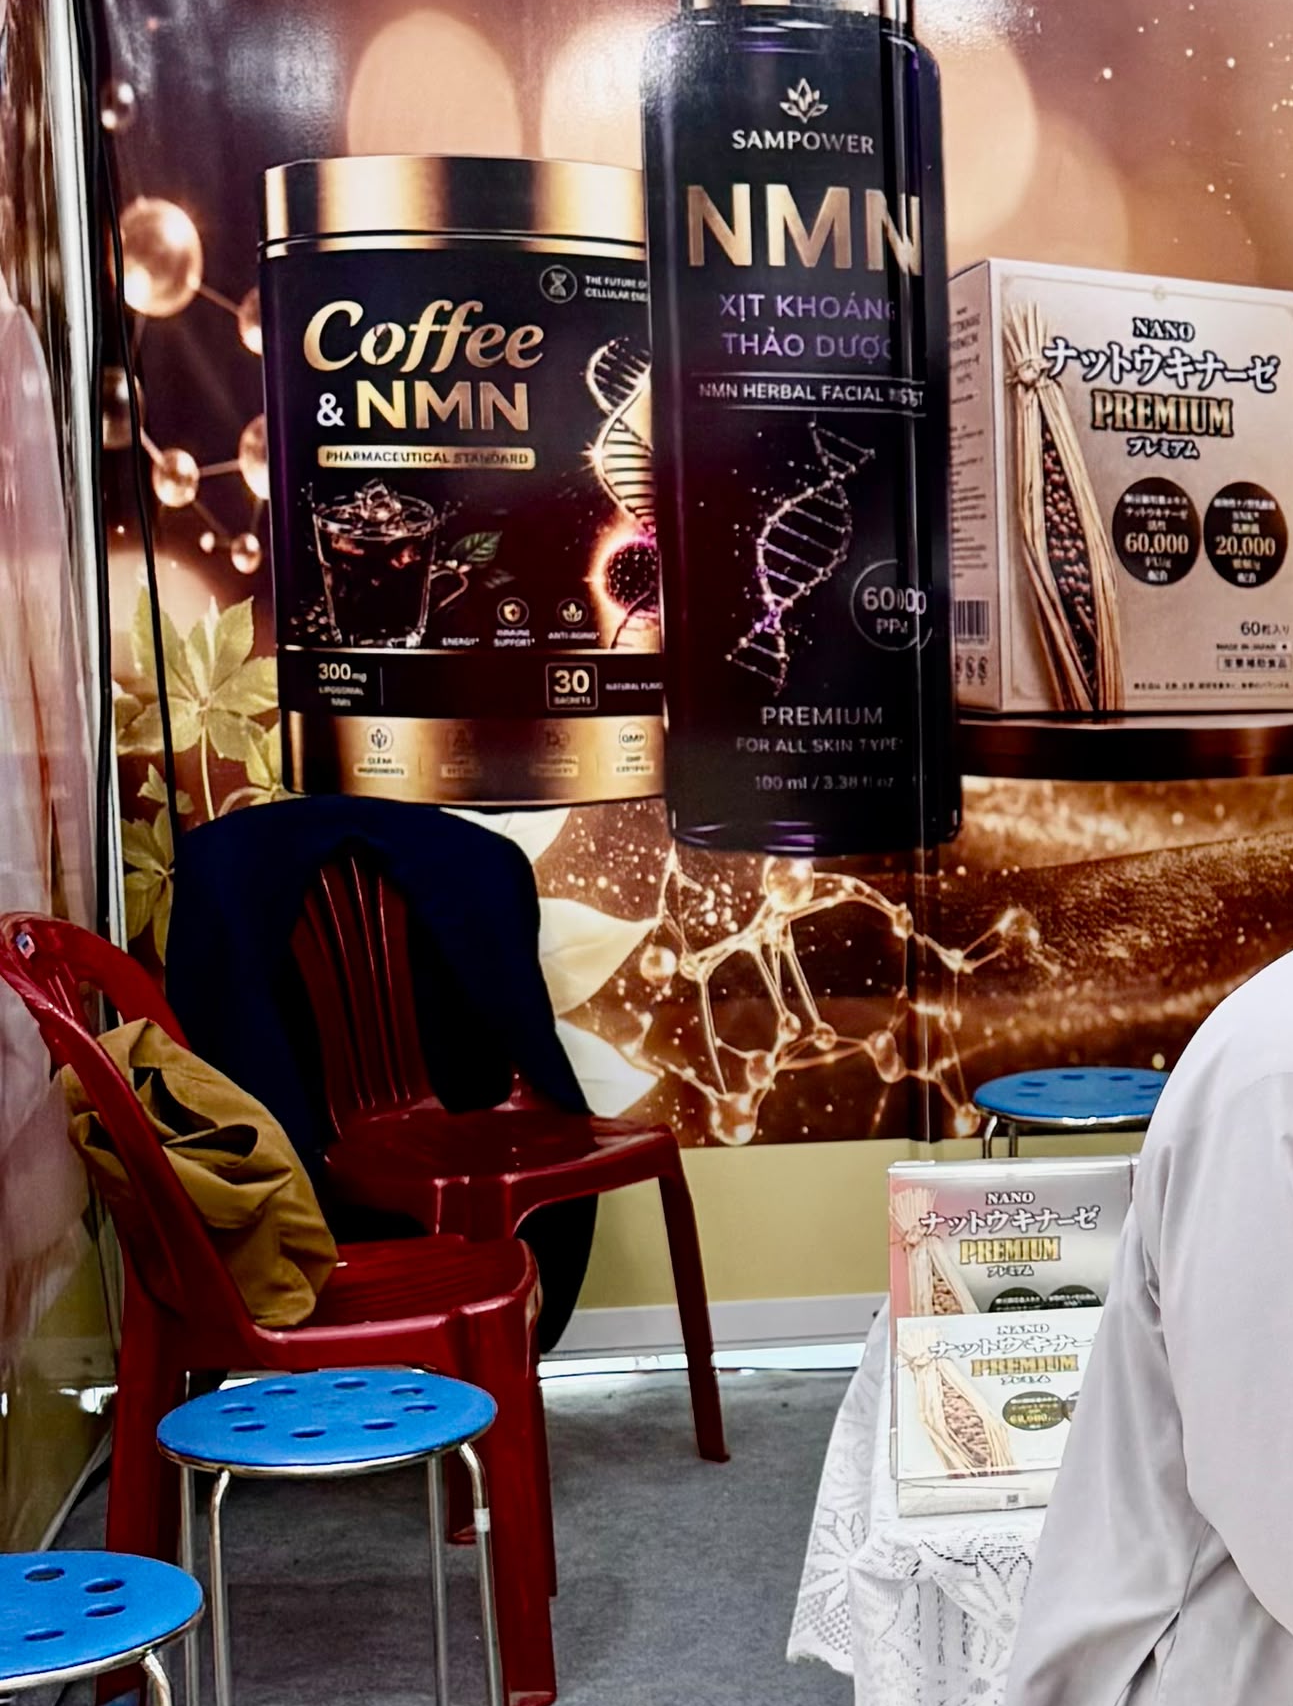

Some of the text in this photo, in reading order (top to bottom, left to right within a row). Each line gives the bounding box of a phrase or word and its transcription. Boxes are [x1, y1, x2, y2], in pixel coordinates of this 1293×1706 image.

[732, 129, 875, 155] SAMPOWER
[687, 182, 923, 277] NMN
[720, 293, 765, 323] XỊT
[303, 299, 545, 374] Coffee
[722, 326, 805, 357] THẢO
[1132, 316, 1196, 342] NANO
[1042, 337, 1281, 394] ナットウキナーゼ
[316, 379, 530, 432] & NMN
[699, 383, 884, 403] NMN HERBAL FACIAL
[1091, 389, 1234, 438] PREMIUM
[325, 450, 529, 465] PHARMACEUTICAL STANDARD
[1127, 437, 1200, 459] プレミアム
[554, 669, 590, 693] 30
[761, 705, 883, 726] PREMIUM
[736, 736, 903, 754] FOR ALL SKIN TYPE
[755, 775, 783, 790] 100
[787, 775, 807, 790] ml
[986, 1190, 1035, 1205] NANO
[919, 1205, 1101, 1236] ナットウキナーゼ
[959, 1236, 1061, 1265] PREMIUM
[997, 1323, 1050, 1335] NANO
[928, 1334, 1095, 1358] ナットウキナー
[971, 1354, 1080, 1377] PREMIUM
